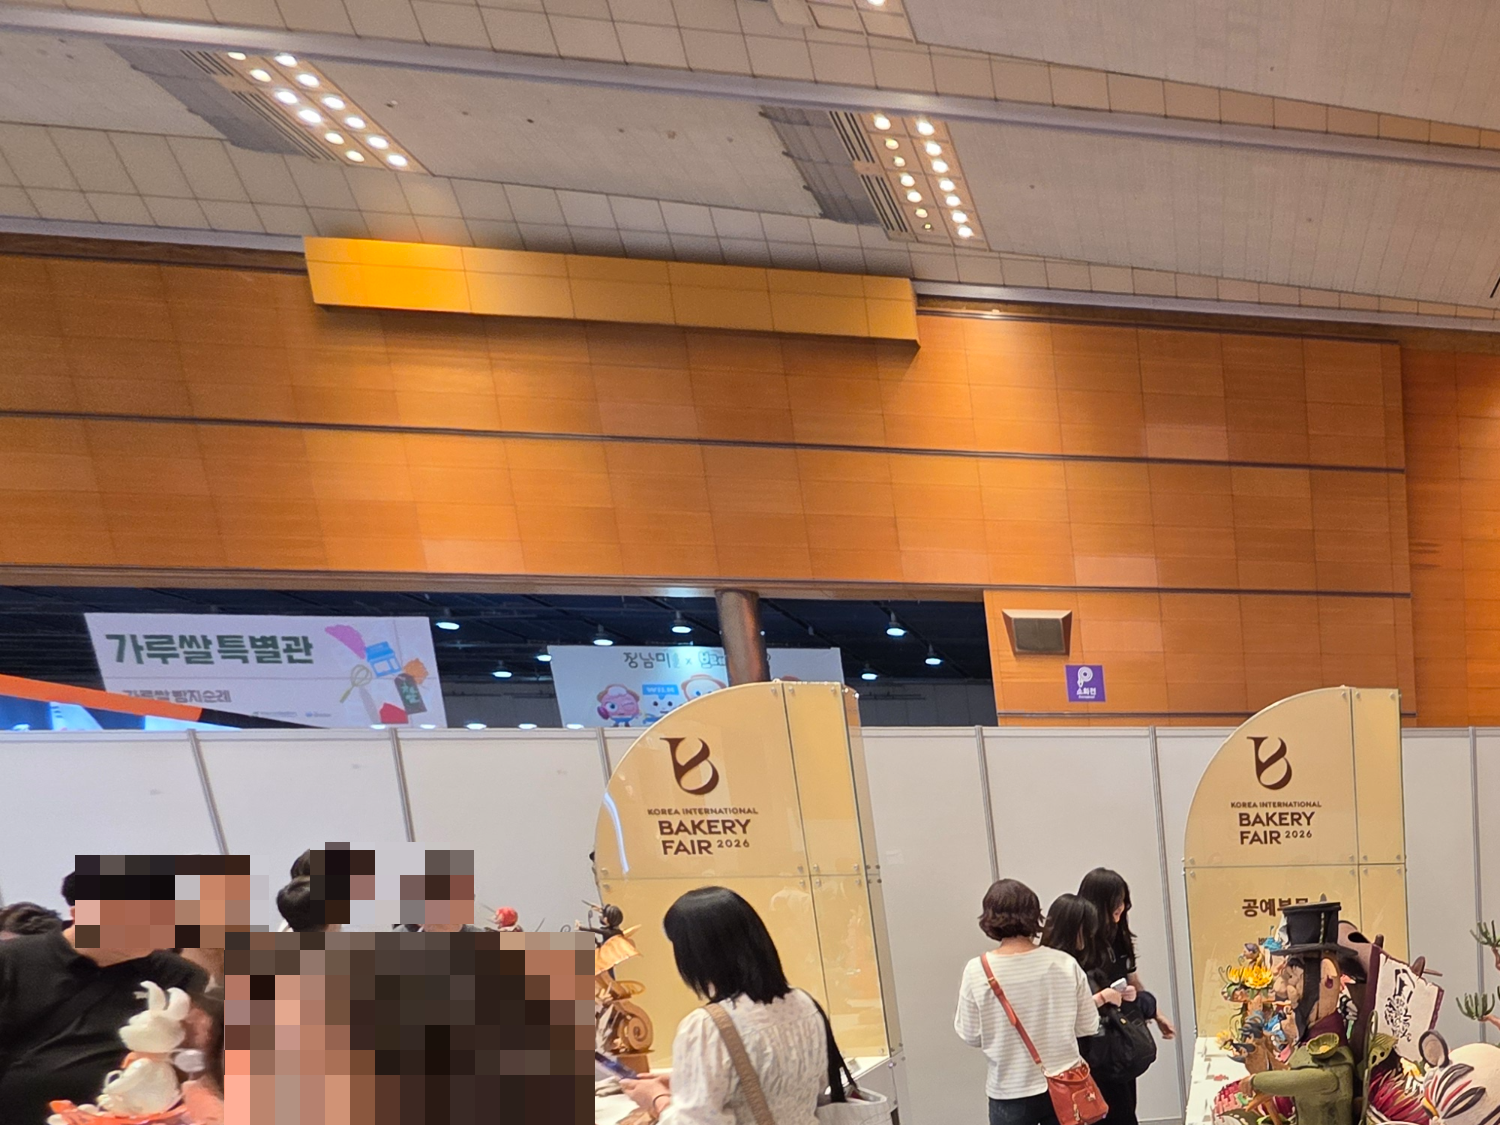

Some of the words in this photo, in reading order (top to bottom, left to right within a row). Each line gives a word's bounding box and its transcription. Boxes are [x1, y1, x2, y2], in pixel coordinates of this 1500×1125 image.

[682, 807, 759, 815] INTERNATIONAL
[1238, 811, 1315, 827] BAKERY
[658, 819, 751, 835] BAKERY
[1240, 830, 1281, 845] FAIR
[1285, 830, 1313, 838] 2026
[662, 840, 713, 855] FAIR
[717, 839, 750, 848] 2026
